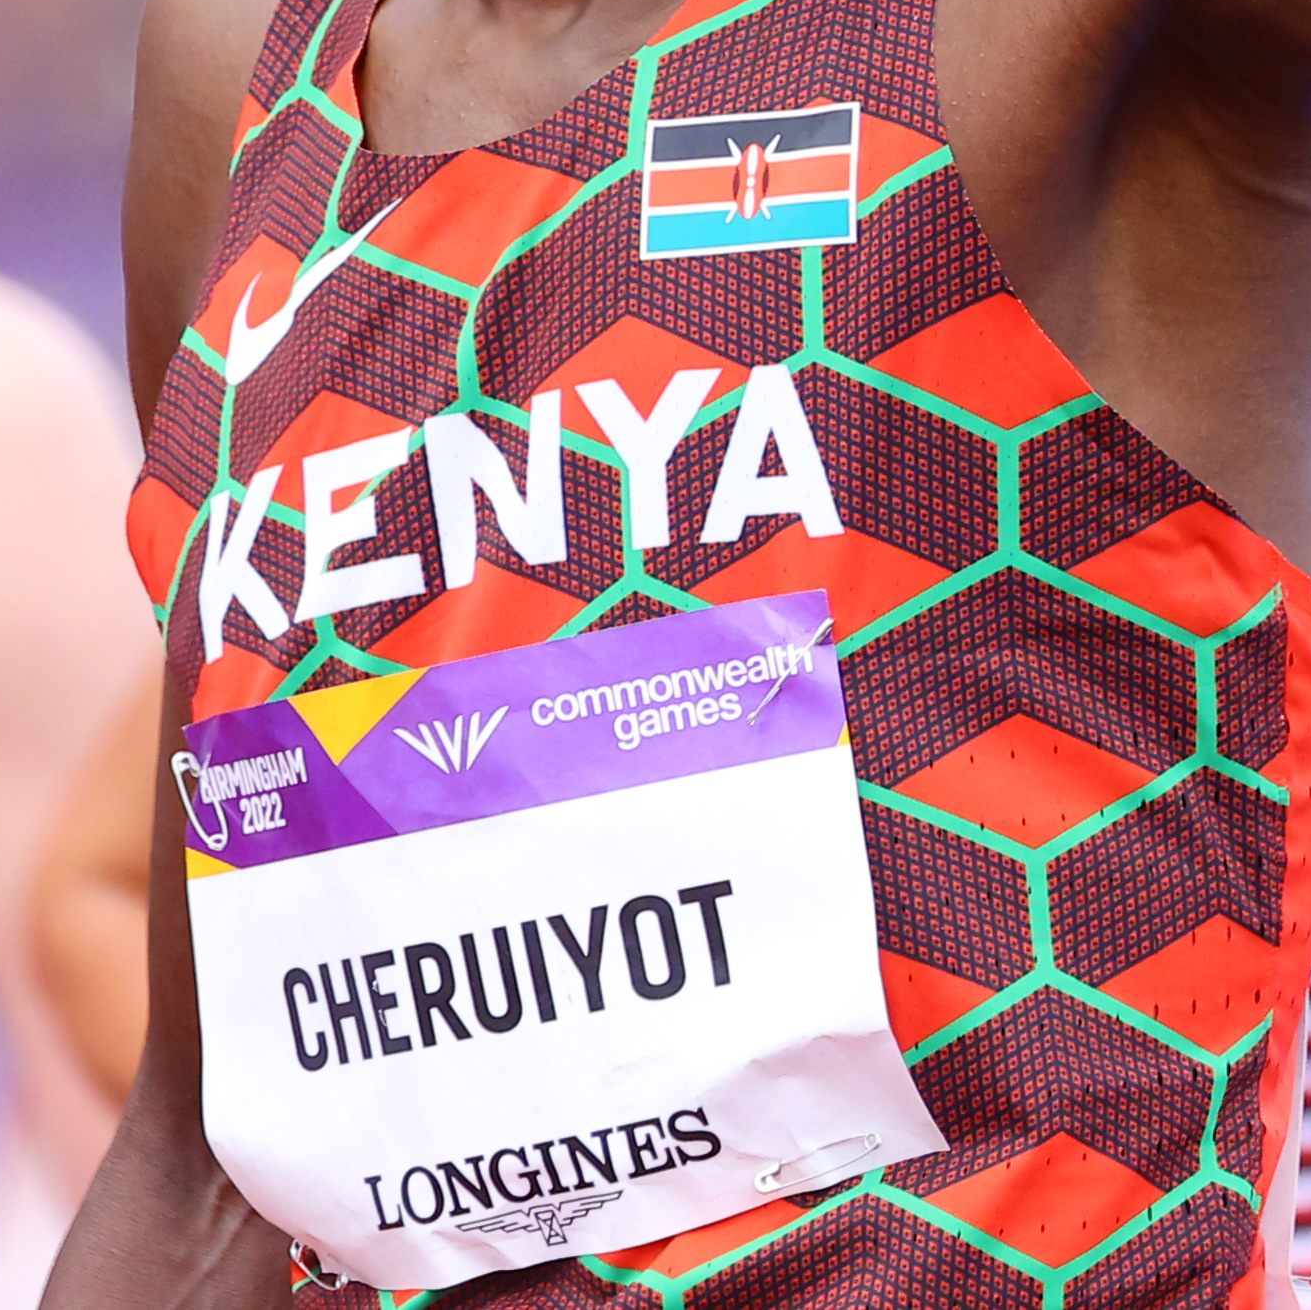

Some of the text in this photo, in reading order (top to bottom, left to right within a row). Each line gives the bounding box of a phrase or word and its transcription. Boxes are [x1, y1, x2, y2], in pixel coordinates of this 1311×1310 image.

[197, 364, 845, 664] KENYA
[531, 643, 813, 726] commonwealth
[613, 692, 741, 751] games
[200, 746, 308, 804] BIRMINGHAM
[239, 791, 287, 835] 2022
[282, 879, 734, 1073] CHERUIYOT
[364, 1107, 722, 1233] LONGINES
